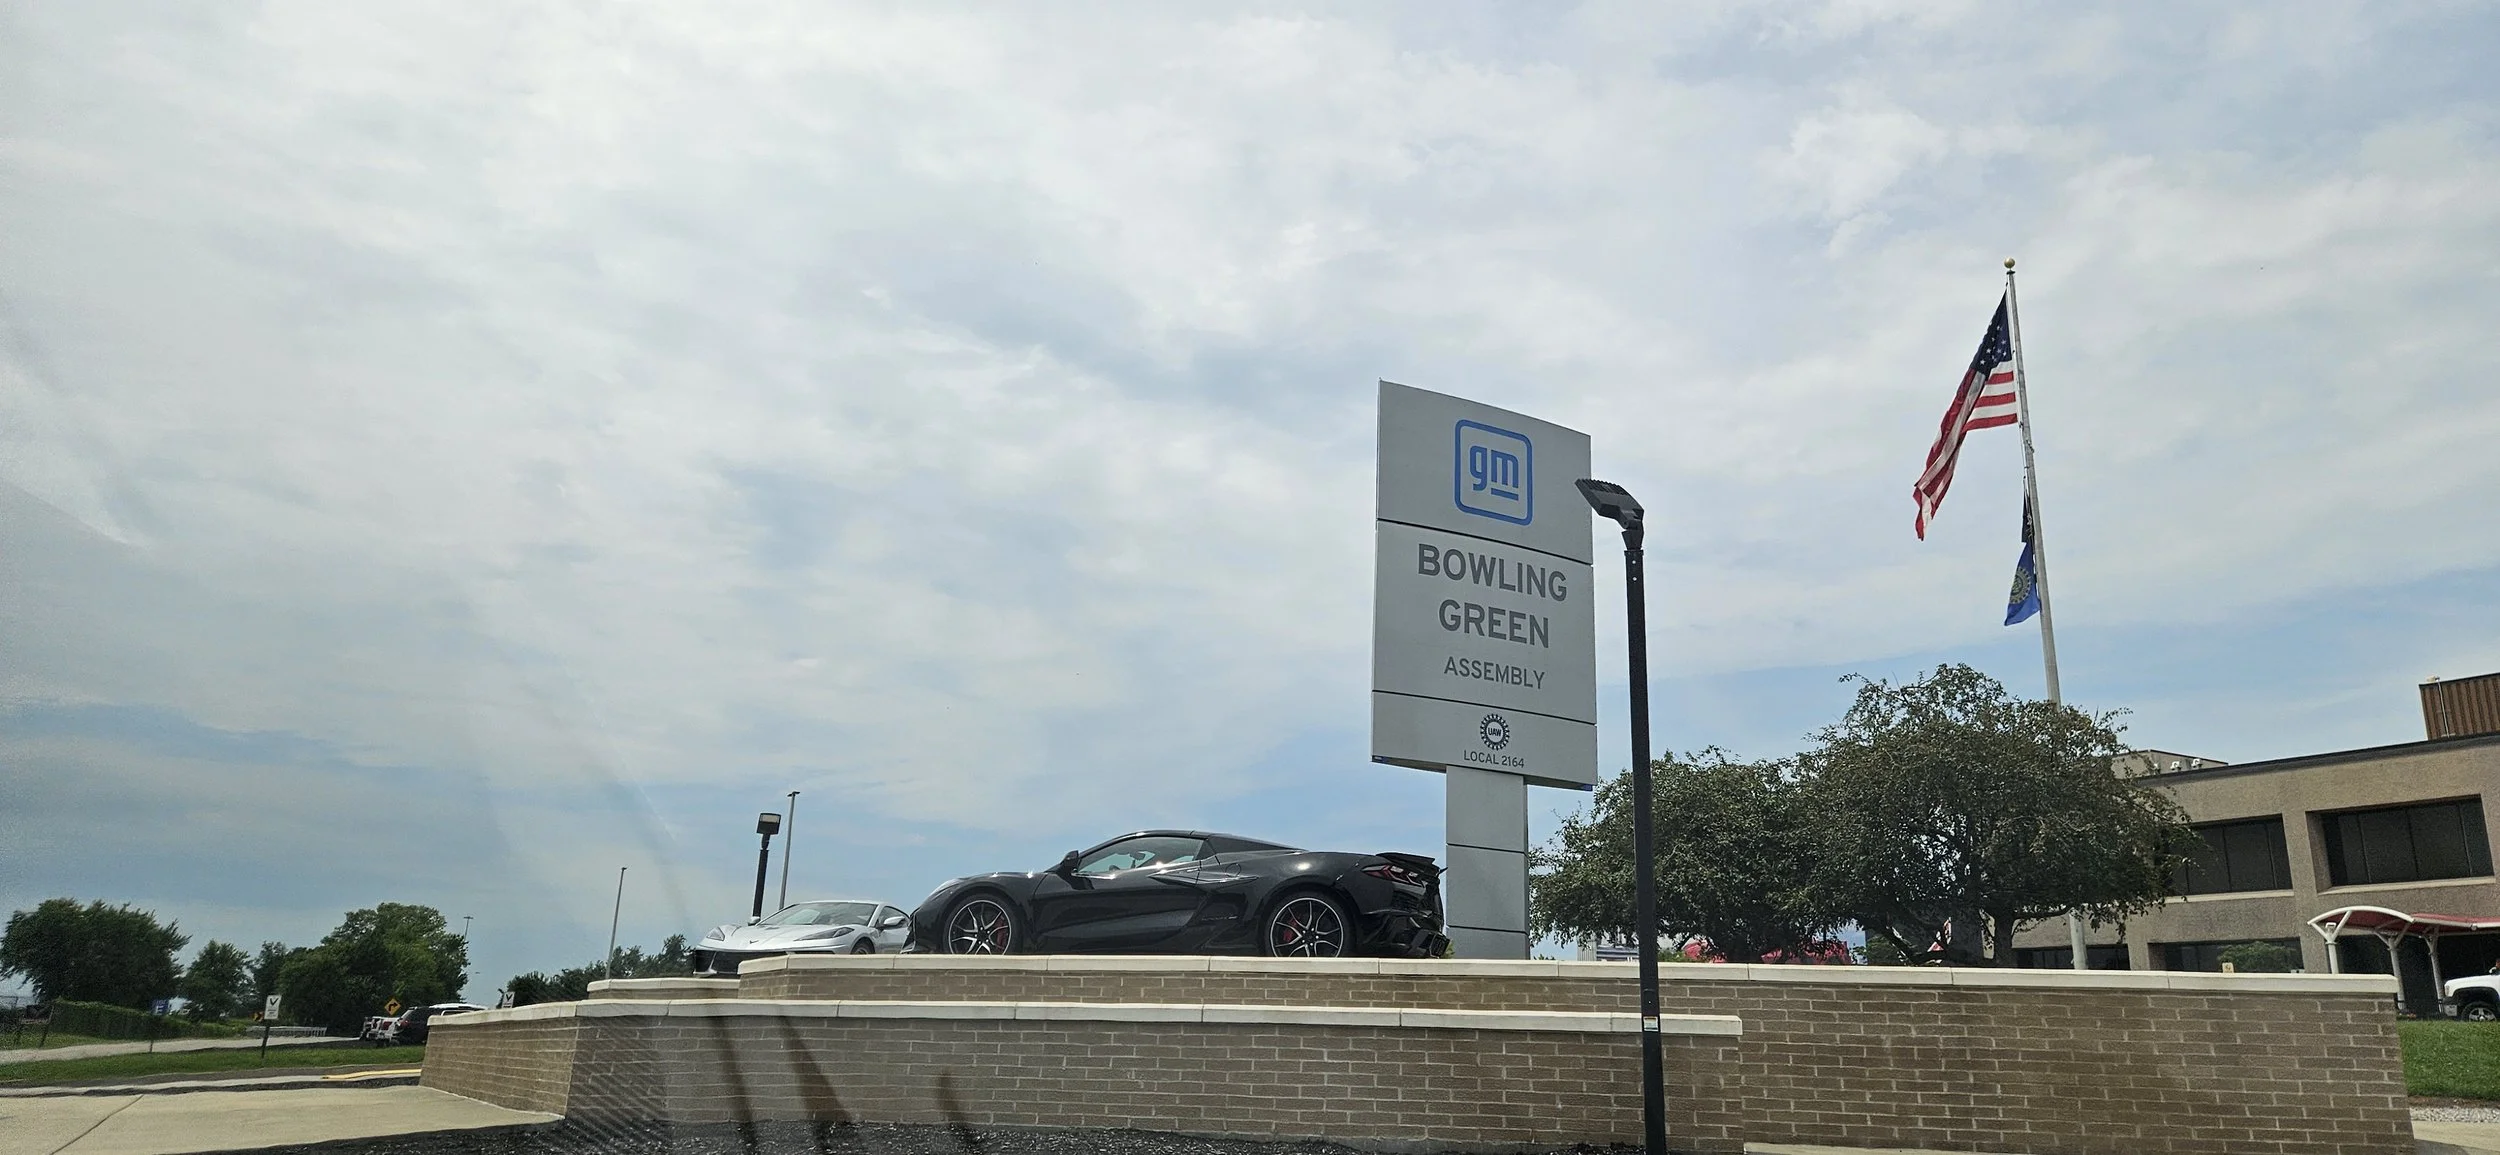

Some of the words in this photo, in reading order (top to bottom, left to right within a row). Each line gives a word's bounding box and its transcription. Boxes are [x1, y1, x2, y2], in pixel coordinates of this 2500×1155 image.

[1469, 444, 1520, 501] gm
[1418, 543, 1567, 602] BOWLING
[1438, 599, 1549, 648] GREEN
[1444, 656, 1545, 690] ASSEMBLY
[1487, 727, 1502, 737] UAW
[1463, 749, 1500, 765] LOCAL
[1501, 755, 1525, 769] 2164
